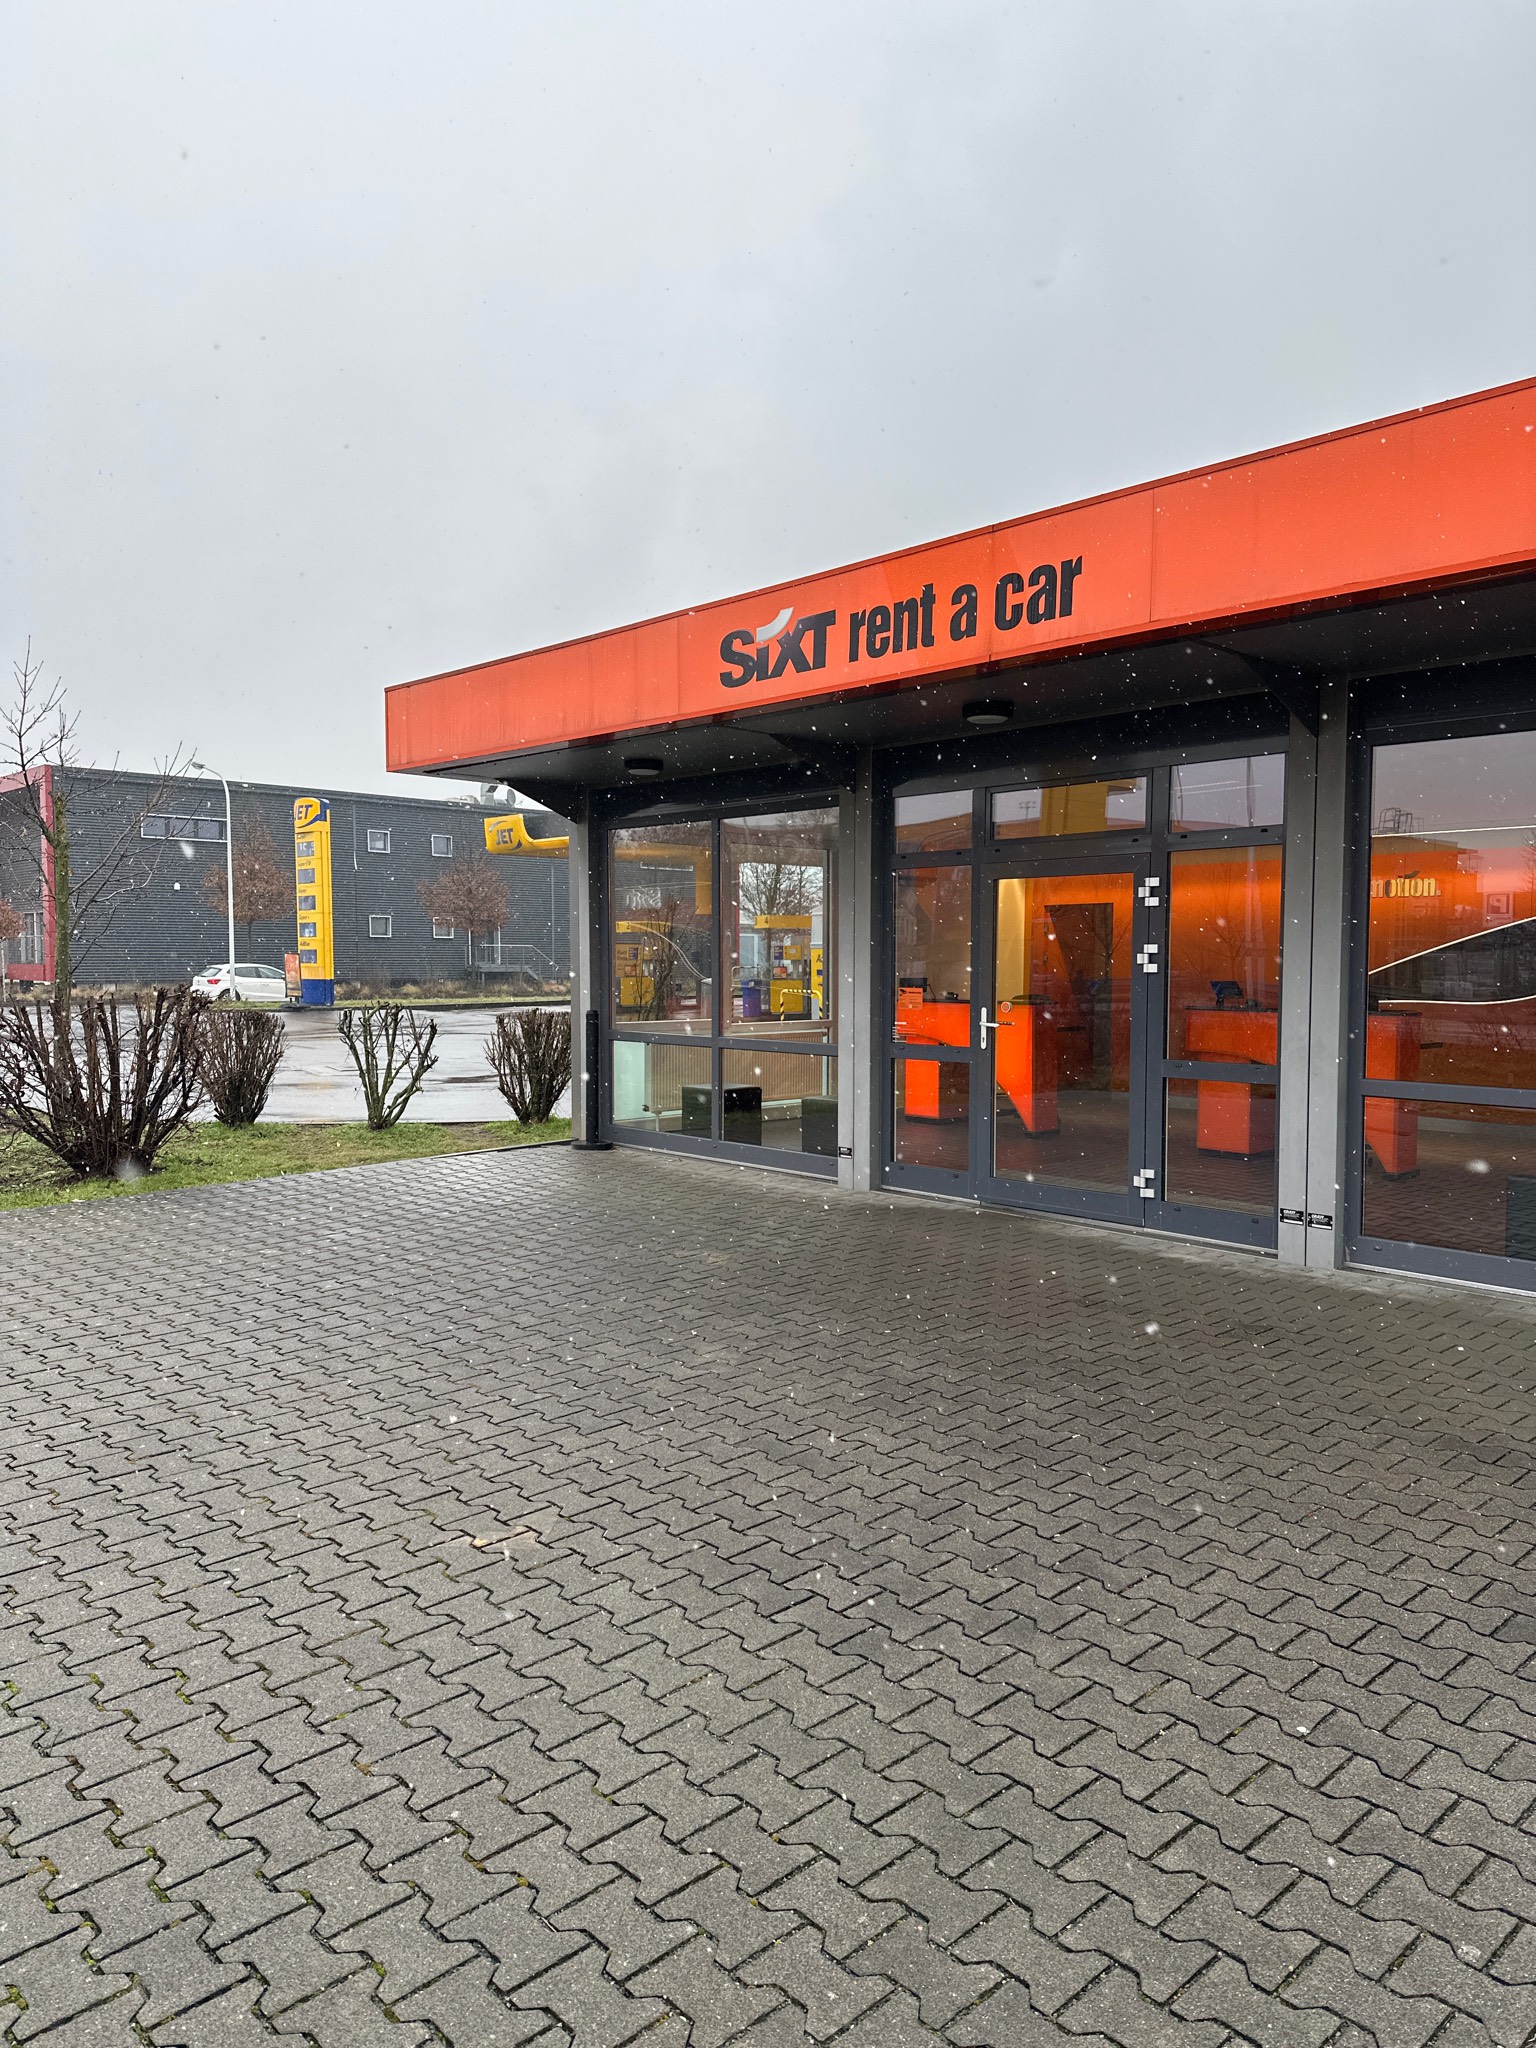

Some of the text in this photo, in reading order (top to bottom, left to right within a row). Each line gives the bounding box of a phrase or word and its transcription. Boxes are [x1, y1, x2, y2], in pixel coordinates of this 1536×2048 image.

[849, 583, 936, 662] rent
[949, 583, 978, 641] a
[995, 555, 1083, 631] car
[496, 828, 514, 846] JET
